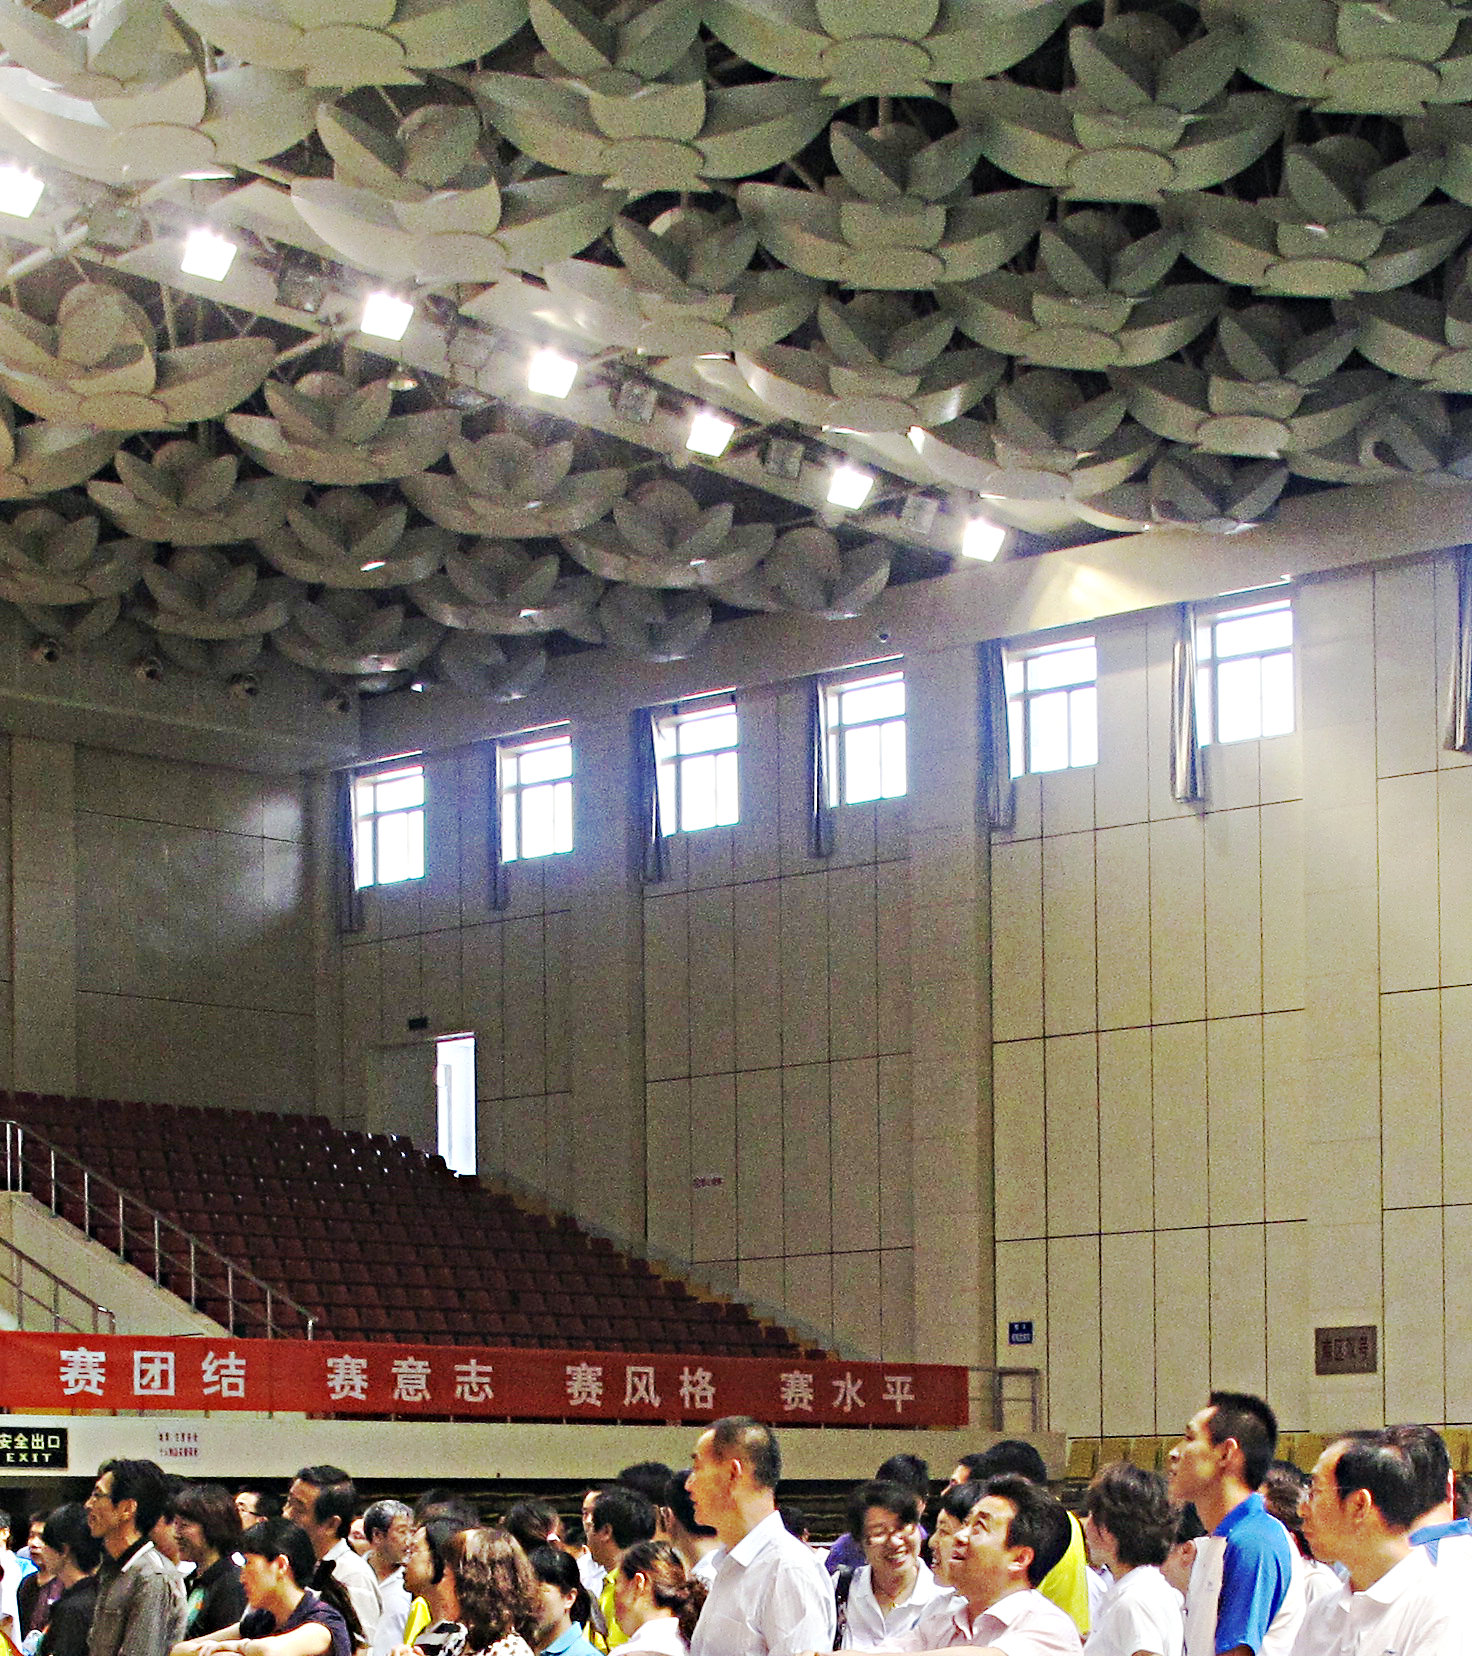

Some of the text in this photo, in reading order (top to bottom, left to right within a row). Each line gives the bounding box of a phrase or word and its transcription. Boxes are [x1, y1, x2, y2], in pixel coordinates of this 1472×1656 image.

[59, 1347, 916, 1413] 赛团结 赛意志 赛风格 赛水平
[6, 1453, 52, 1462] EXIT
